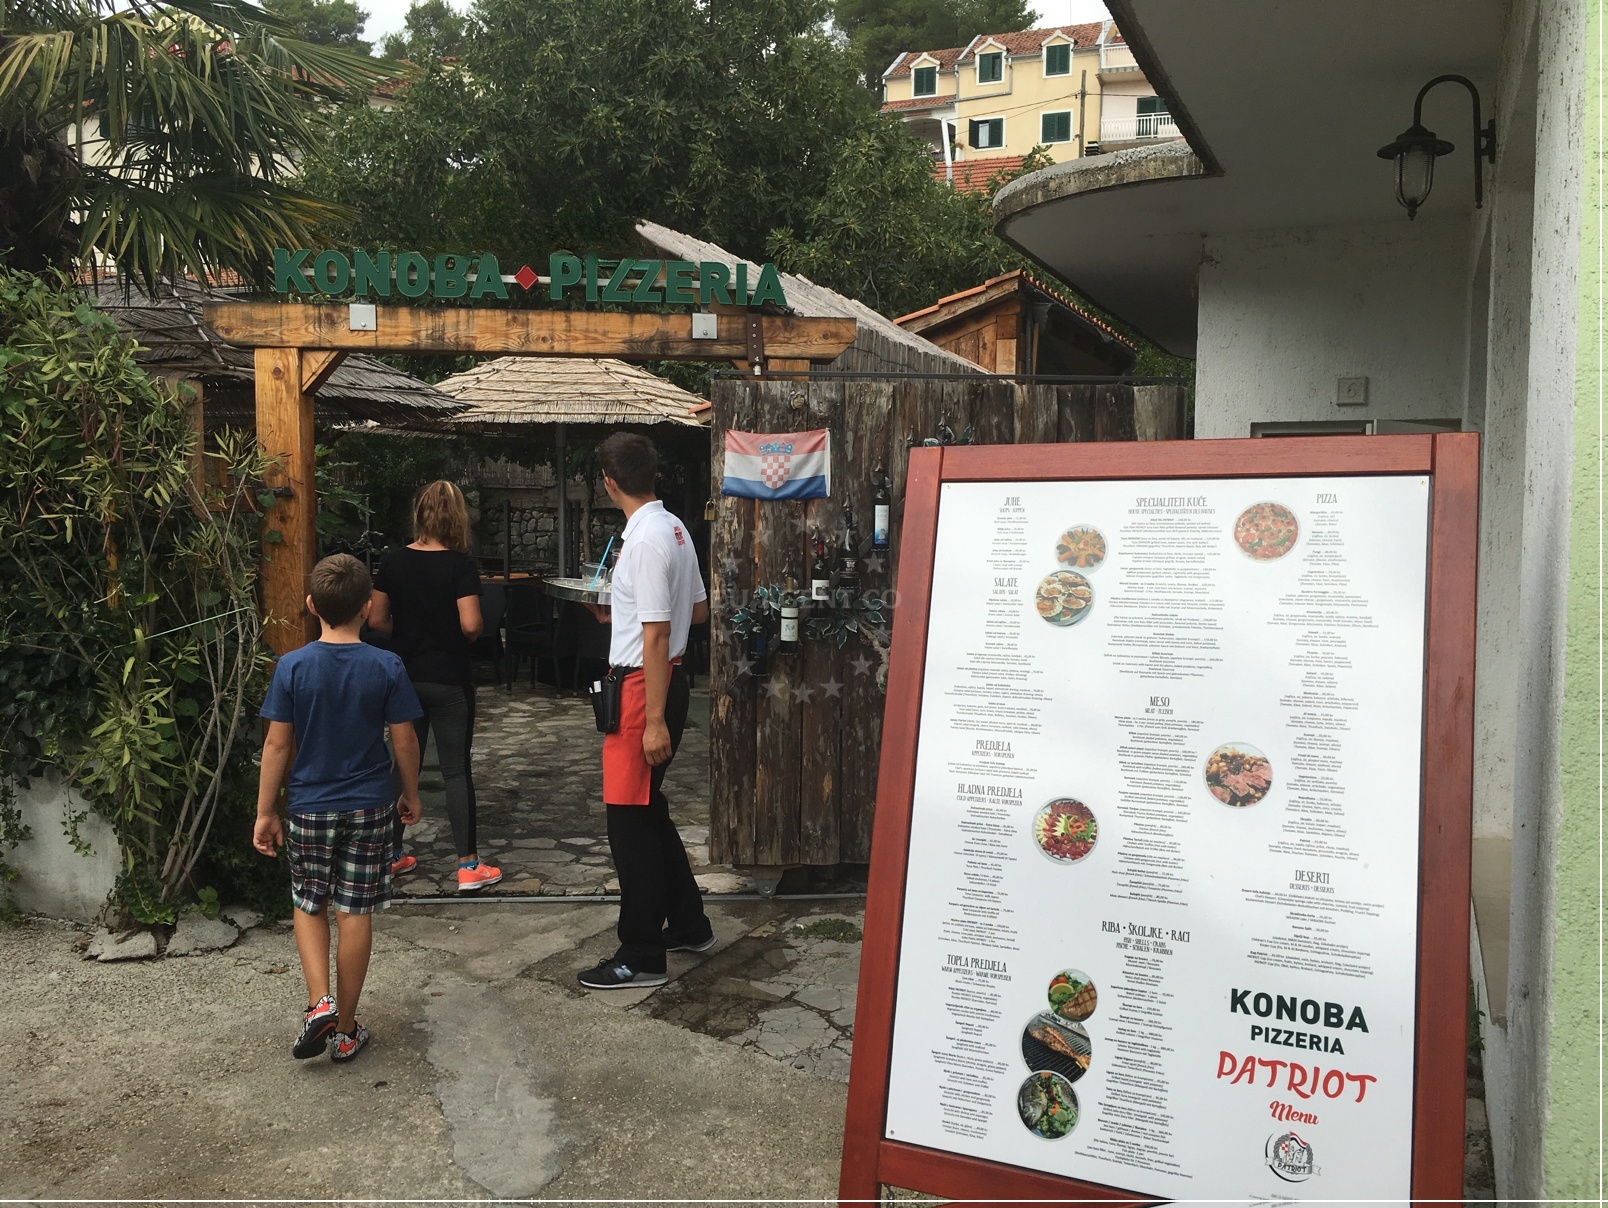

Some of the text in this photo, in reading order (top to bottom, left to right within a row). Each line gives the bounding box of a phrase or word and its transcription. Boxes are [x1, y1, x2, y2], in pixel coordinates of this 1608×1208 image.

[275, 248, 787, 306] KONOBA PIZZERIA
[1347, 381, 1356, 398] 6
[1004, 497, 1021, 506] JUHE
[1136, 498, 1185, 507] SPECIJALITETI
[1317, 494, 1337, 503] PIZZA
[994, 578, 1018, 587] SALATE
[1150, 696, 1170, 707] MESO
[976, 739, 1011, 751] PREDJELA
[958, 783, 1023, 798] HLADNA PREDJELA
[1295, 869, 1330, 884] DESERTI
[1290, 883, 1335, 894] DESSERTS DESSERTS
[1102, 921, 1190, 942] RIBA ŠKOLJKE RACI
[1133, 944, 1150, 952] SCHALEN
[1135, 938, 1149, 946] SHELLS
[947, 954, 1007, 972] TOPLA PREDJELA
[1230, 988, 1369, 1033] KONOBA
[1251, 1025, 1345, 1055] PIZZERIA
[1217, 1051, 1377, 1103] PATRIOT
[1270, 1100, 1319, 1125] Menu
[1278, 1162, 1306, 1172] PATRIOT
